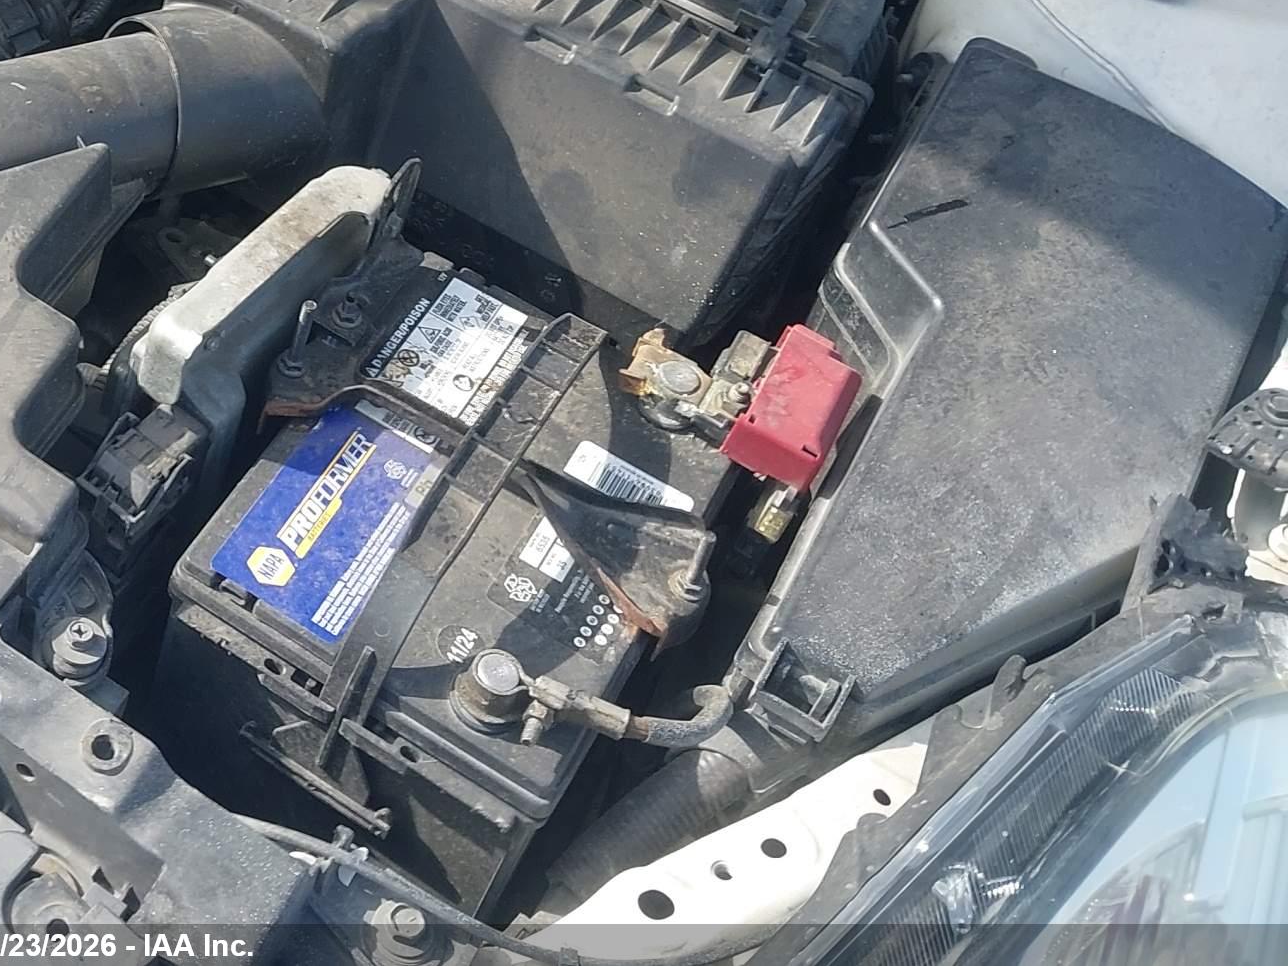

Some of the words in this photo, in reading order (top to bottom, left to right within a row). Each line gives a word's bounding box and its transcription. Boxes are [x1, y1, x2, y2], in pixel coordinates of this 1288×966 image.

[279, 433, 374, 552] PROFORMER
[257, 553, 284, 581] NAPA
[446, 627, 478, 663] 11/24
